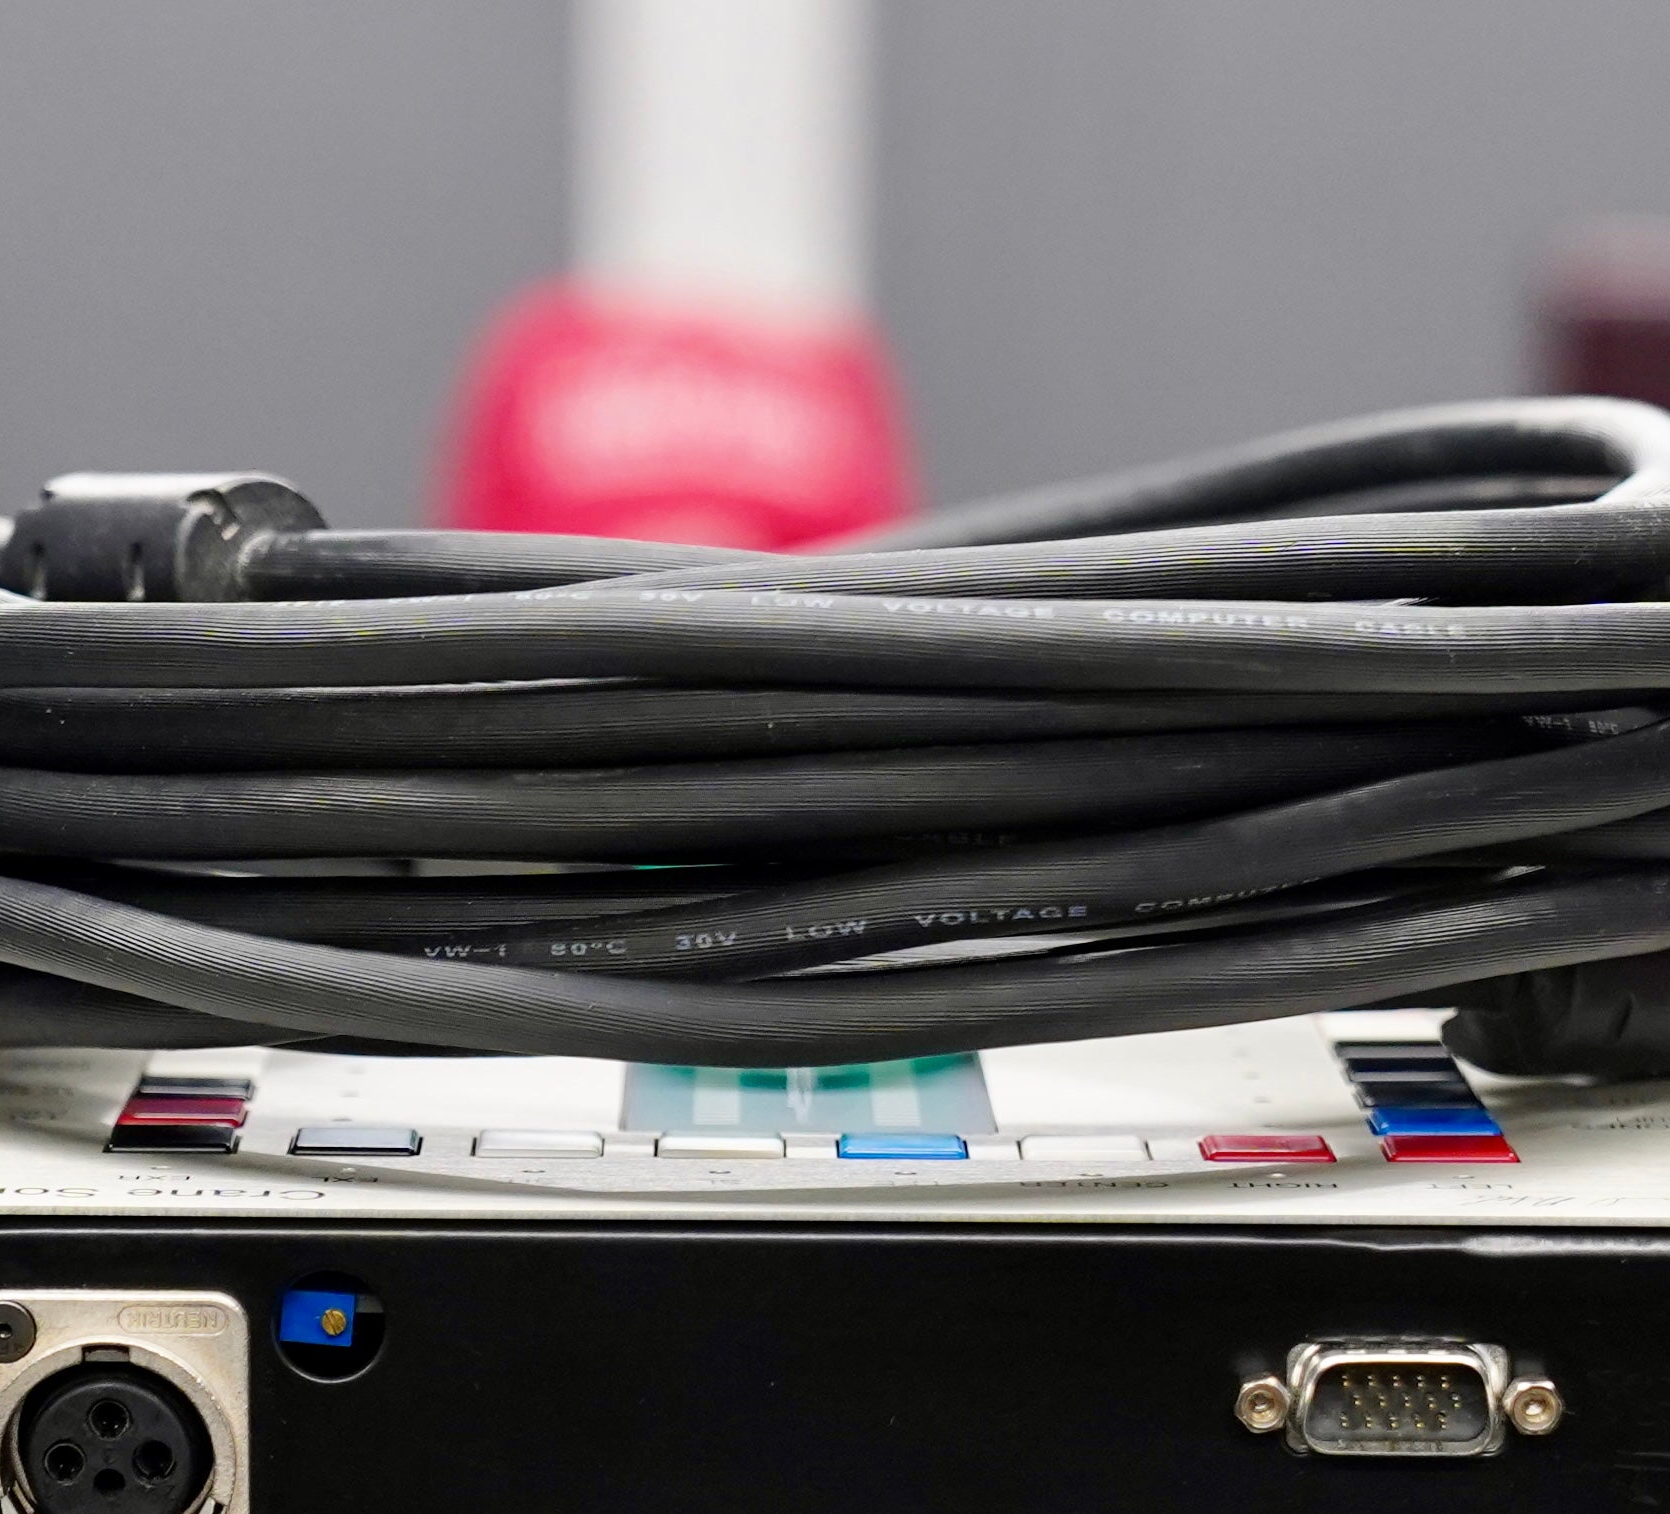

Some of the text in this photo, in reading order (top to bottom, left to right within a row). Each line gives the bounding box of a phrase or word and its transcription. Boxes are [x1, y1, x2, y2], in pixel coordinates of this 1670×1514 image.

[751, 594, 833, 609] LOW
[881, 601, 1056, 620] VOLTAGE
[1103, 610, 1308, 630] COMPUTER
[1356, 621, 1464, 635] CABLE
[424, 943, 507, 957] VW-1
[785, 921, 868, 940] LOW
[915, 904, 1089, 927] VOLTAGE
[125, 1188, 327, 1201] Crane
